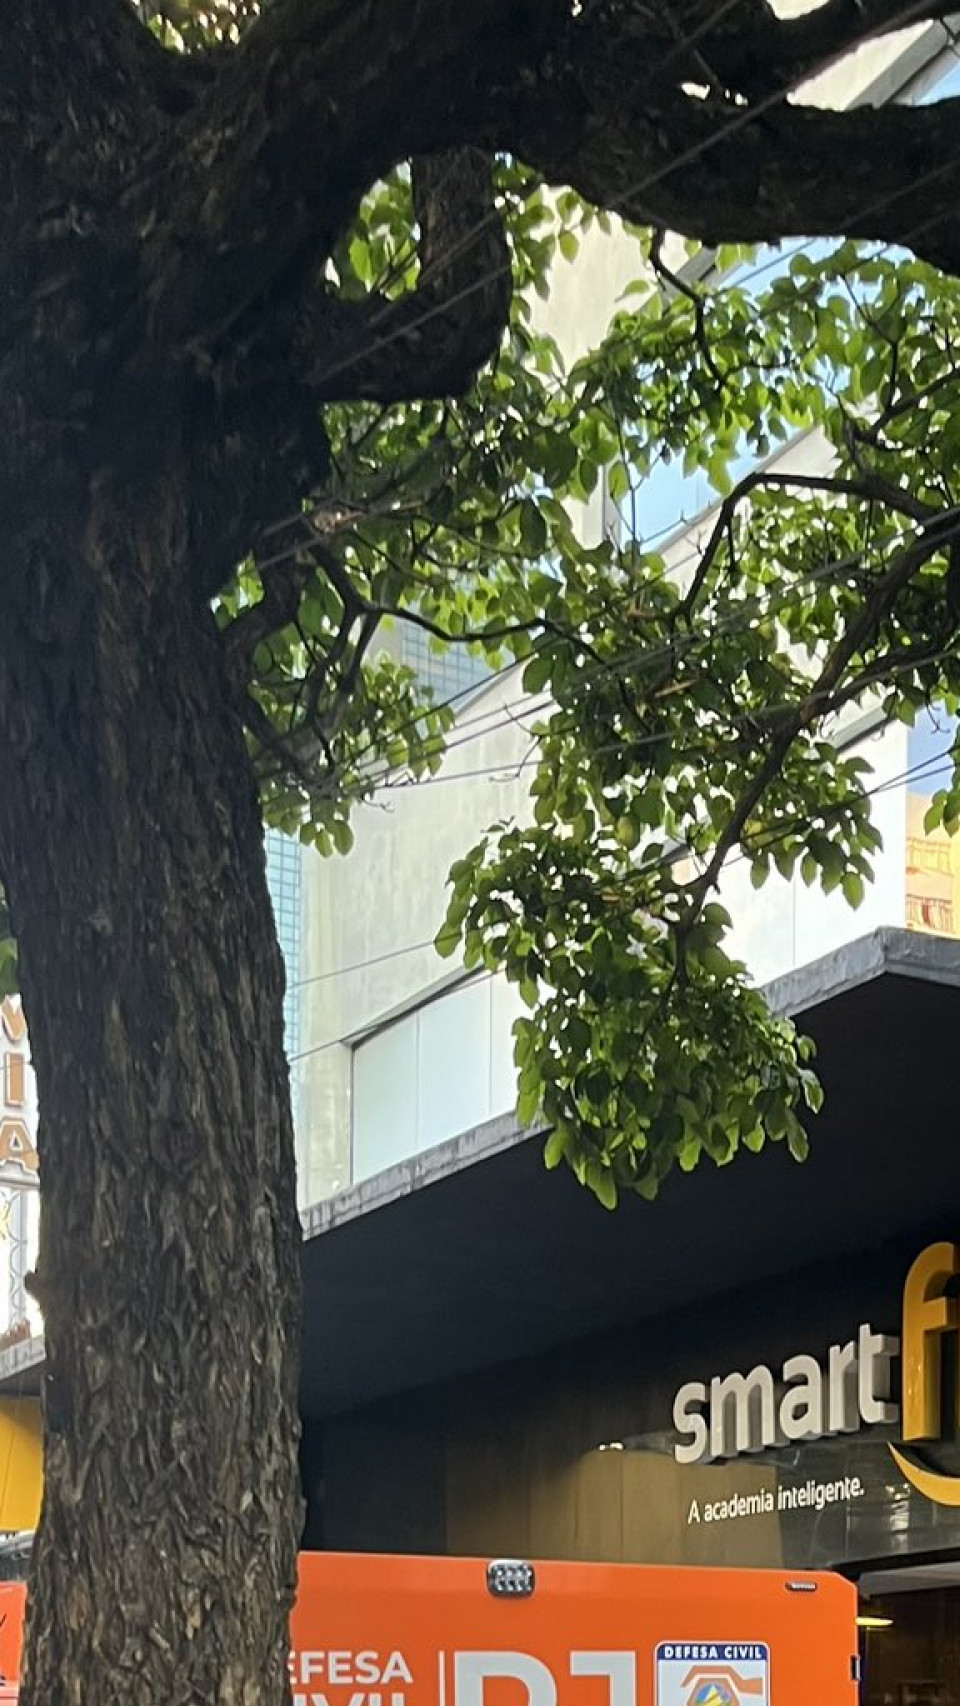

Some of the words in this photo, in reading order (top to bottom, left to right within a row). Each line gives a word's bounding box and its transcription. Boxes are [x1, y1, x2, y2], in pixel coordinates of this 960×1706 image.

[673, 1323, 892, 1465] smart
[687, 1500, 701, 1524] A
[704, 1488, 774, 1523] academia
[777, 1476, 865, 1511] inteligente.
[664, 1645, 719, 1659] DEFESA
[724, 1645, 763, 1659] CIVIL
